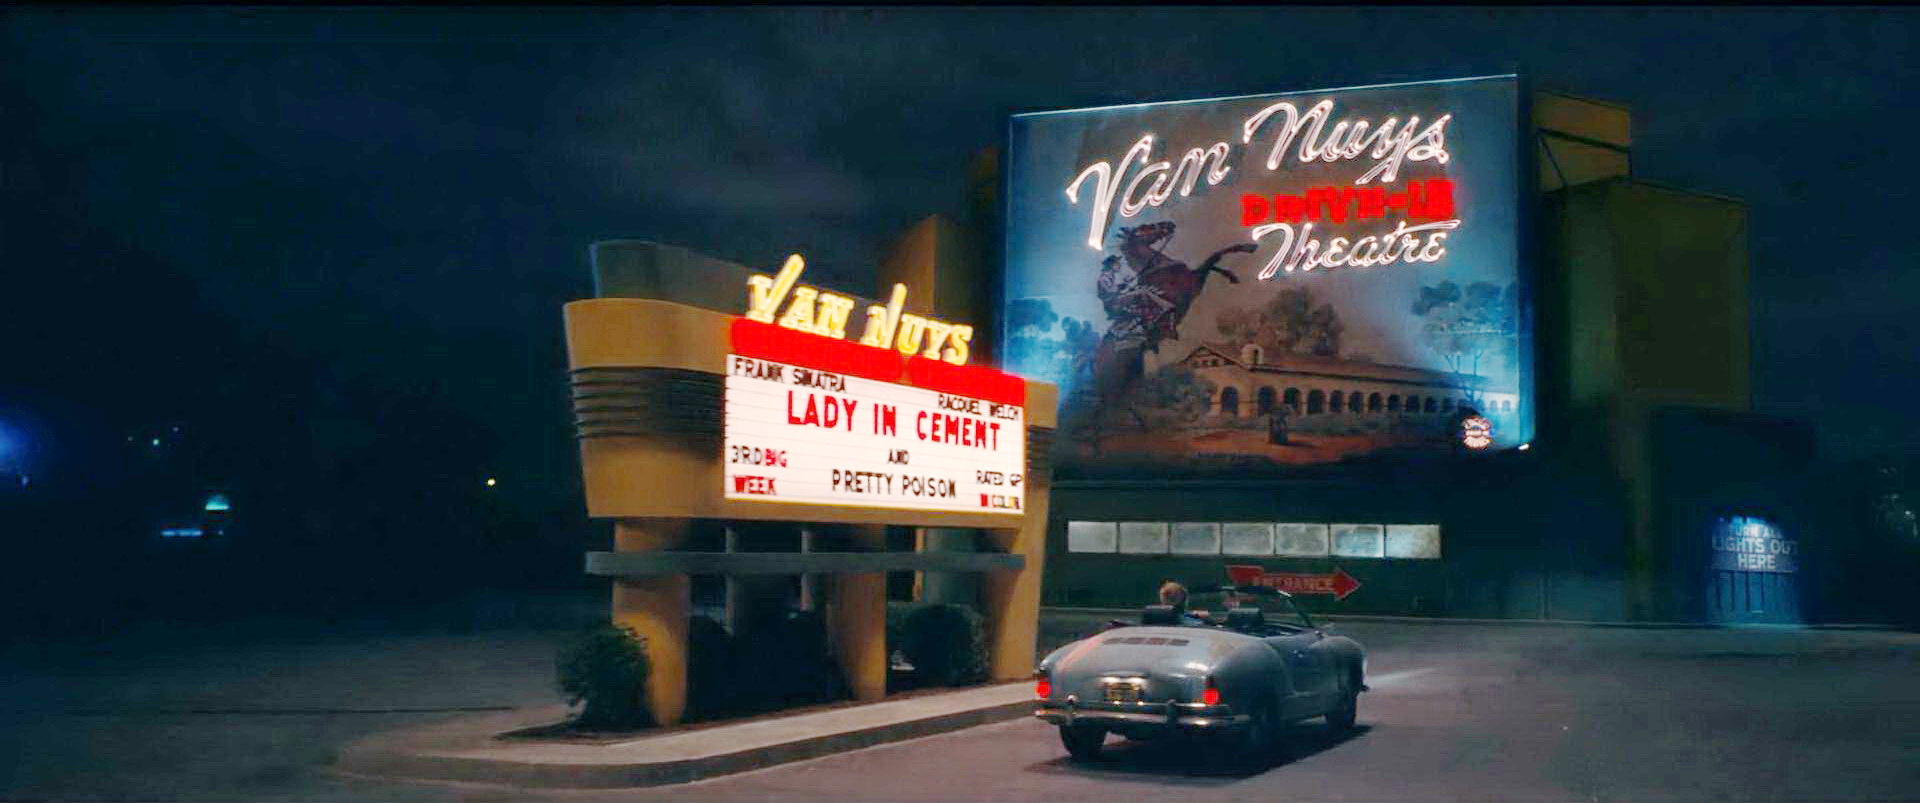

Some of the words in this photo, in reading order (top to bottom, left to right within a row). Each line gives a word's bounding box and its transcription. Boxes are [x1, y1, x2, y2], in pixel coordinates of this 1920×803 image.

[1066, 134, 1231, 250] Van
[1243, 99, 1451, 184] Nuys
[745, 253, 855, 339] VAN
[861, 283, 974, 366] NUYS
[734, 357, 783, 383] FRANK
[793, 368, 846, 393] SINATRA
[787, 390, 858, 431] LADY
[874, 403, 897, 437] IN
[916, 410, 1001, 451] CEMENT
[731, 445, 762, 466] 3RD
[887, 449, 909, 465] AND
[733, 475, 777, 496] WEEK
[832, 469, 893, 495] PRETTY
[902, 474, 957, 498] POISON
[976, 470, 1004, 487] RATED
[1711, 536, 1766, 554] LIGHTS
[1769, 539, 1798, 556] OUT
[1737, 553, 1777, 570] HERE
